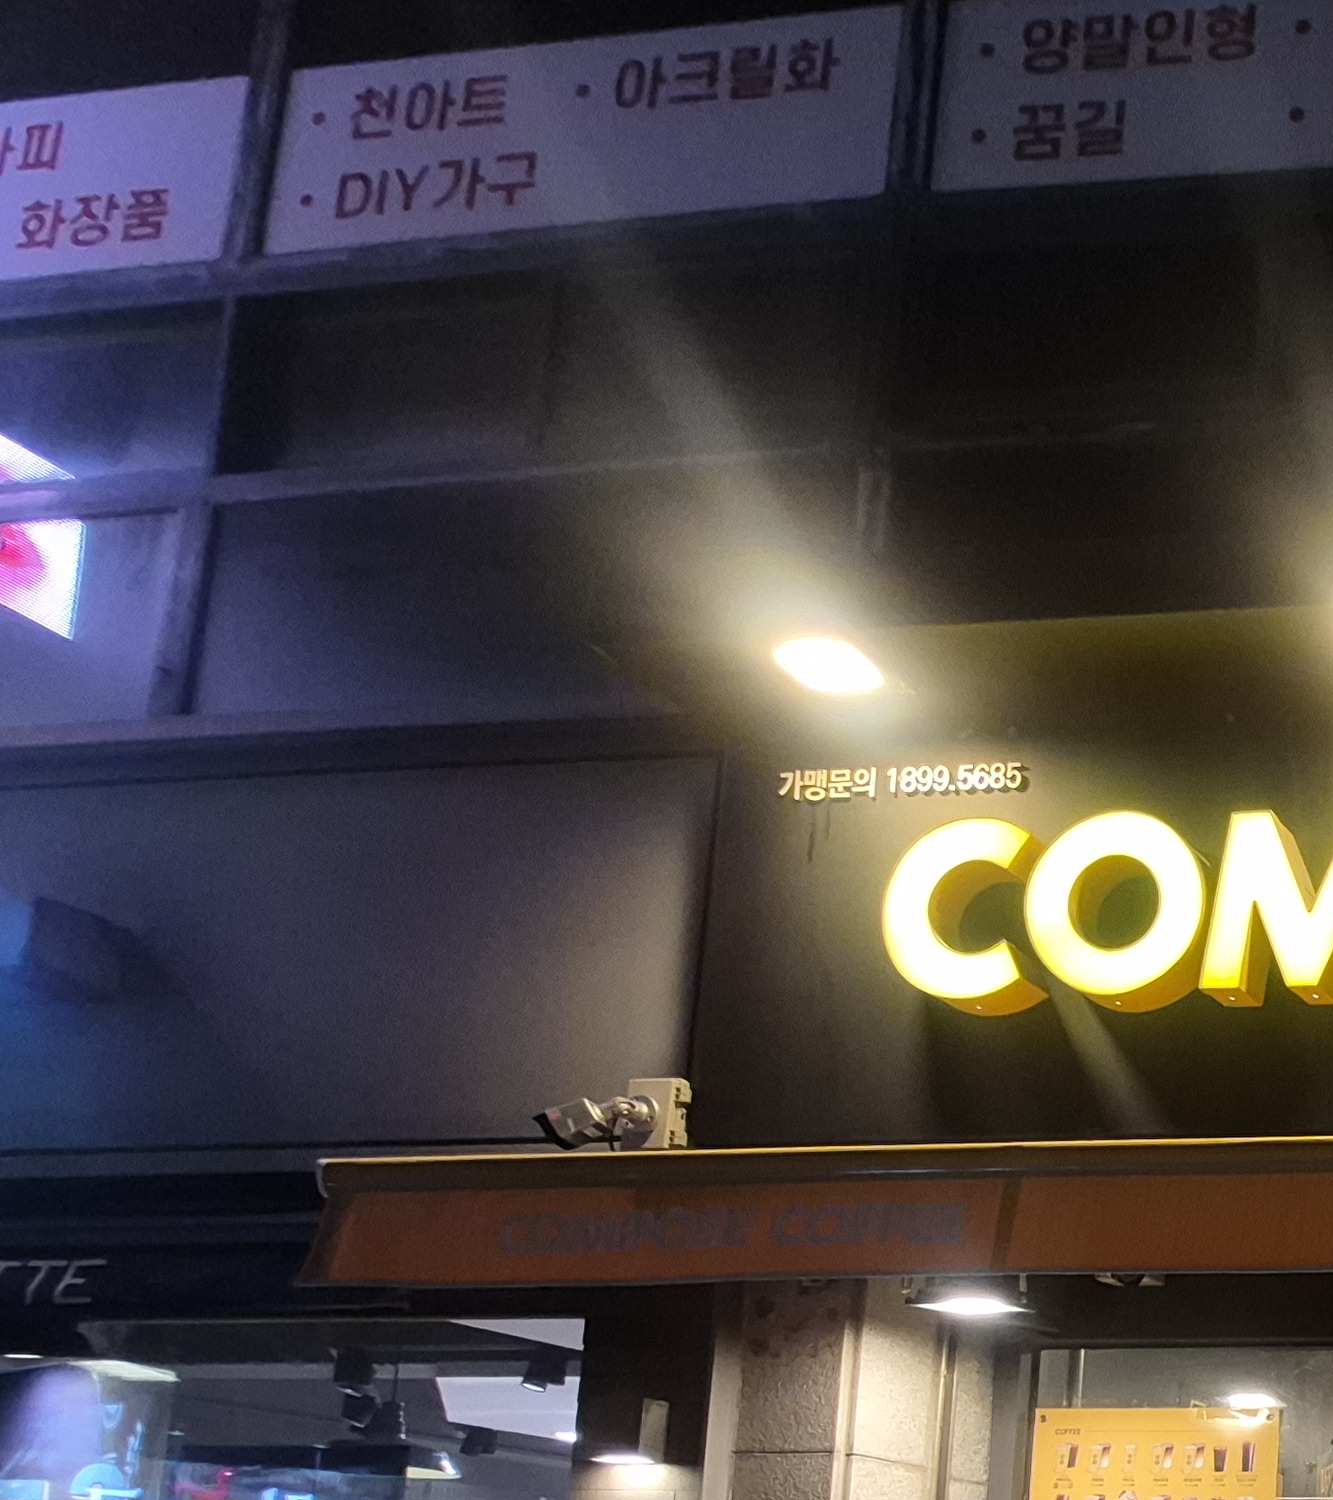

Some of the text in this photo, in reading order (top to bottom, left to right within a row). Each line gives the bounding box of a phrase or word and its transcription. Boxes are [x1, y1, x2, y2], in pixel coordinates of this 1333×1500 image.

[1022, 3, 1258, 75] 양말인형
[615, 38, 840, 108] 아크릴화
[350, 74, 508, 140] 천아트
[1011, 98, 1127, 162] 꿈길
[15, 188, 170, 249] 화장품
[334, 152, 539, 220] DIY가구
[778, 762, 1024, 801] 가맹문의 1899.5685
